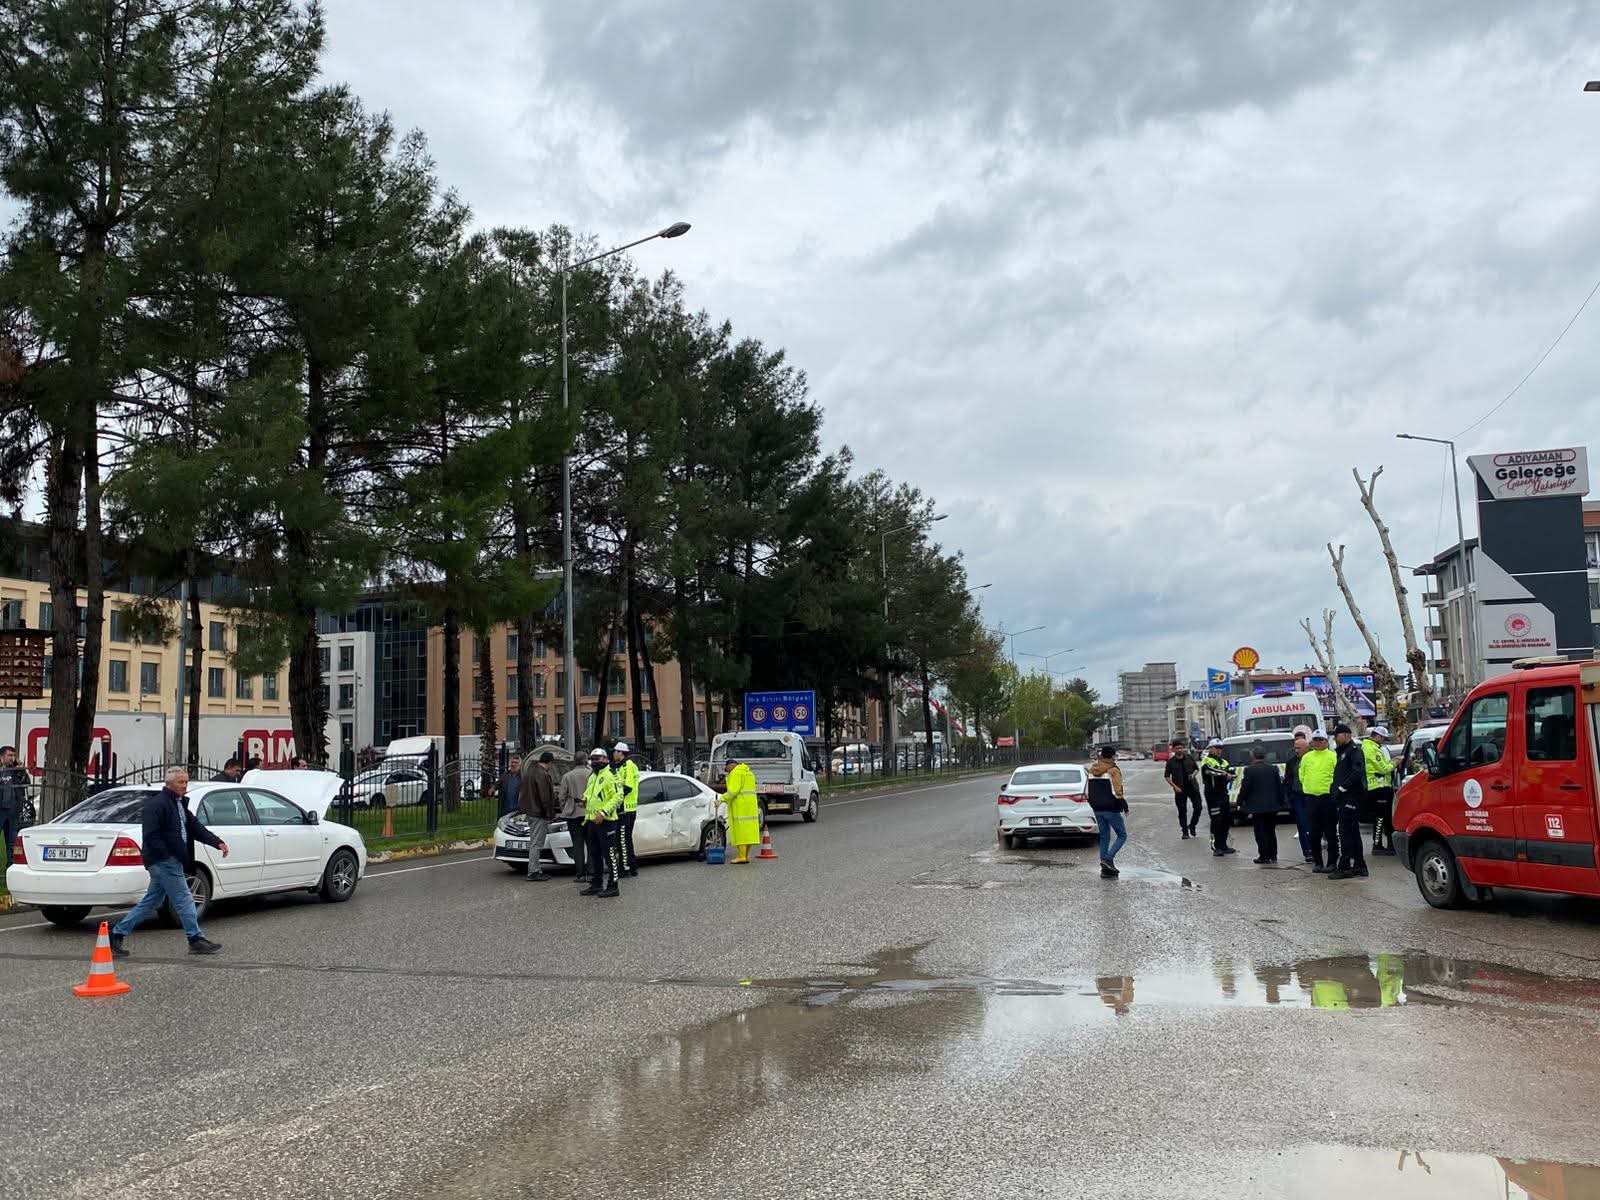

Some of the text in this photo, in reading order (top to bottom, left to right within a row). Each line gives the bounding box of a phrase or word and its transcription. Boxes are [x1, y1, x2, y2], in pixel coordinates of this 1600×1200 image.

[1507, 452, 1562, 464] ADIYAMAN
[1495, 463, 1576, 480] Geleceğe
[755, 710, 764, 718] 70
[796, 708, 805, 717] 50
[1251, 703, 1306, 715] AMBULANS
[1547, 817, 1561, 829] 112
[48, 847, 56, 858] 06
